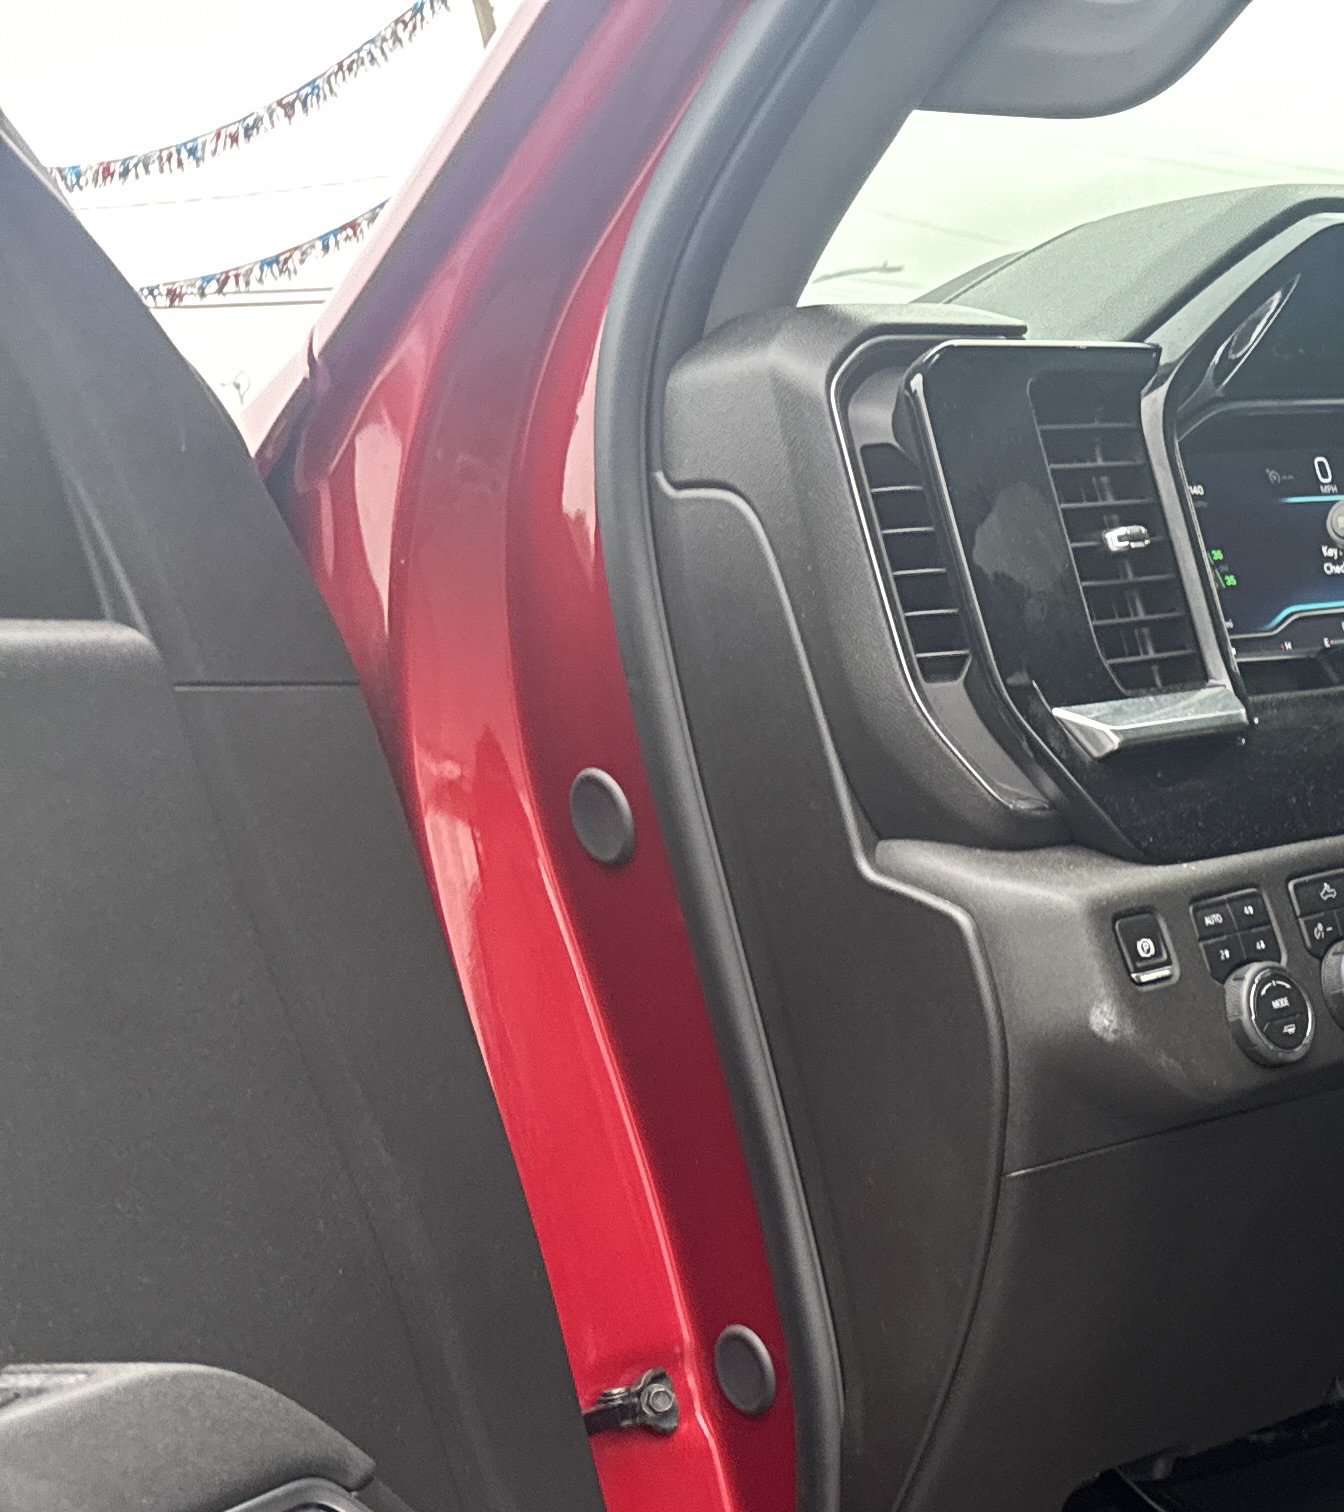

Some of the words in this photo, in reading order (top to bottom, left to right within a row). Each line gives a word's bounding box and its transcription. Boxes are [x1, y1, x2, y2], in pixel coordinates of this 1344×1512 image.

[1314, 456, 1333, 484] 0
[1320, 484, 1338, 495] MPH
[1204, 912, 1223, 927] AUTO
